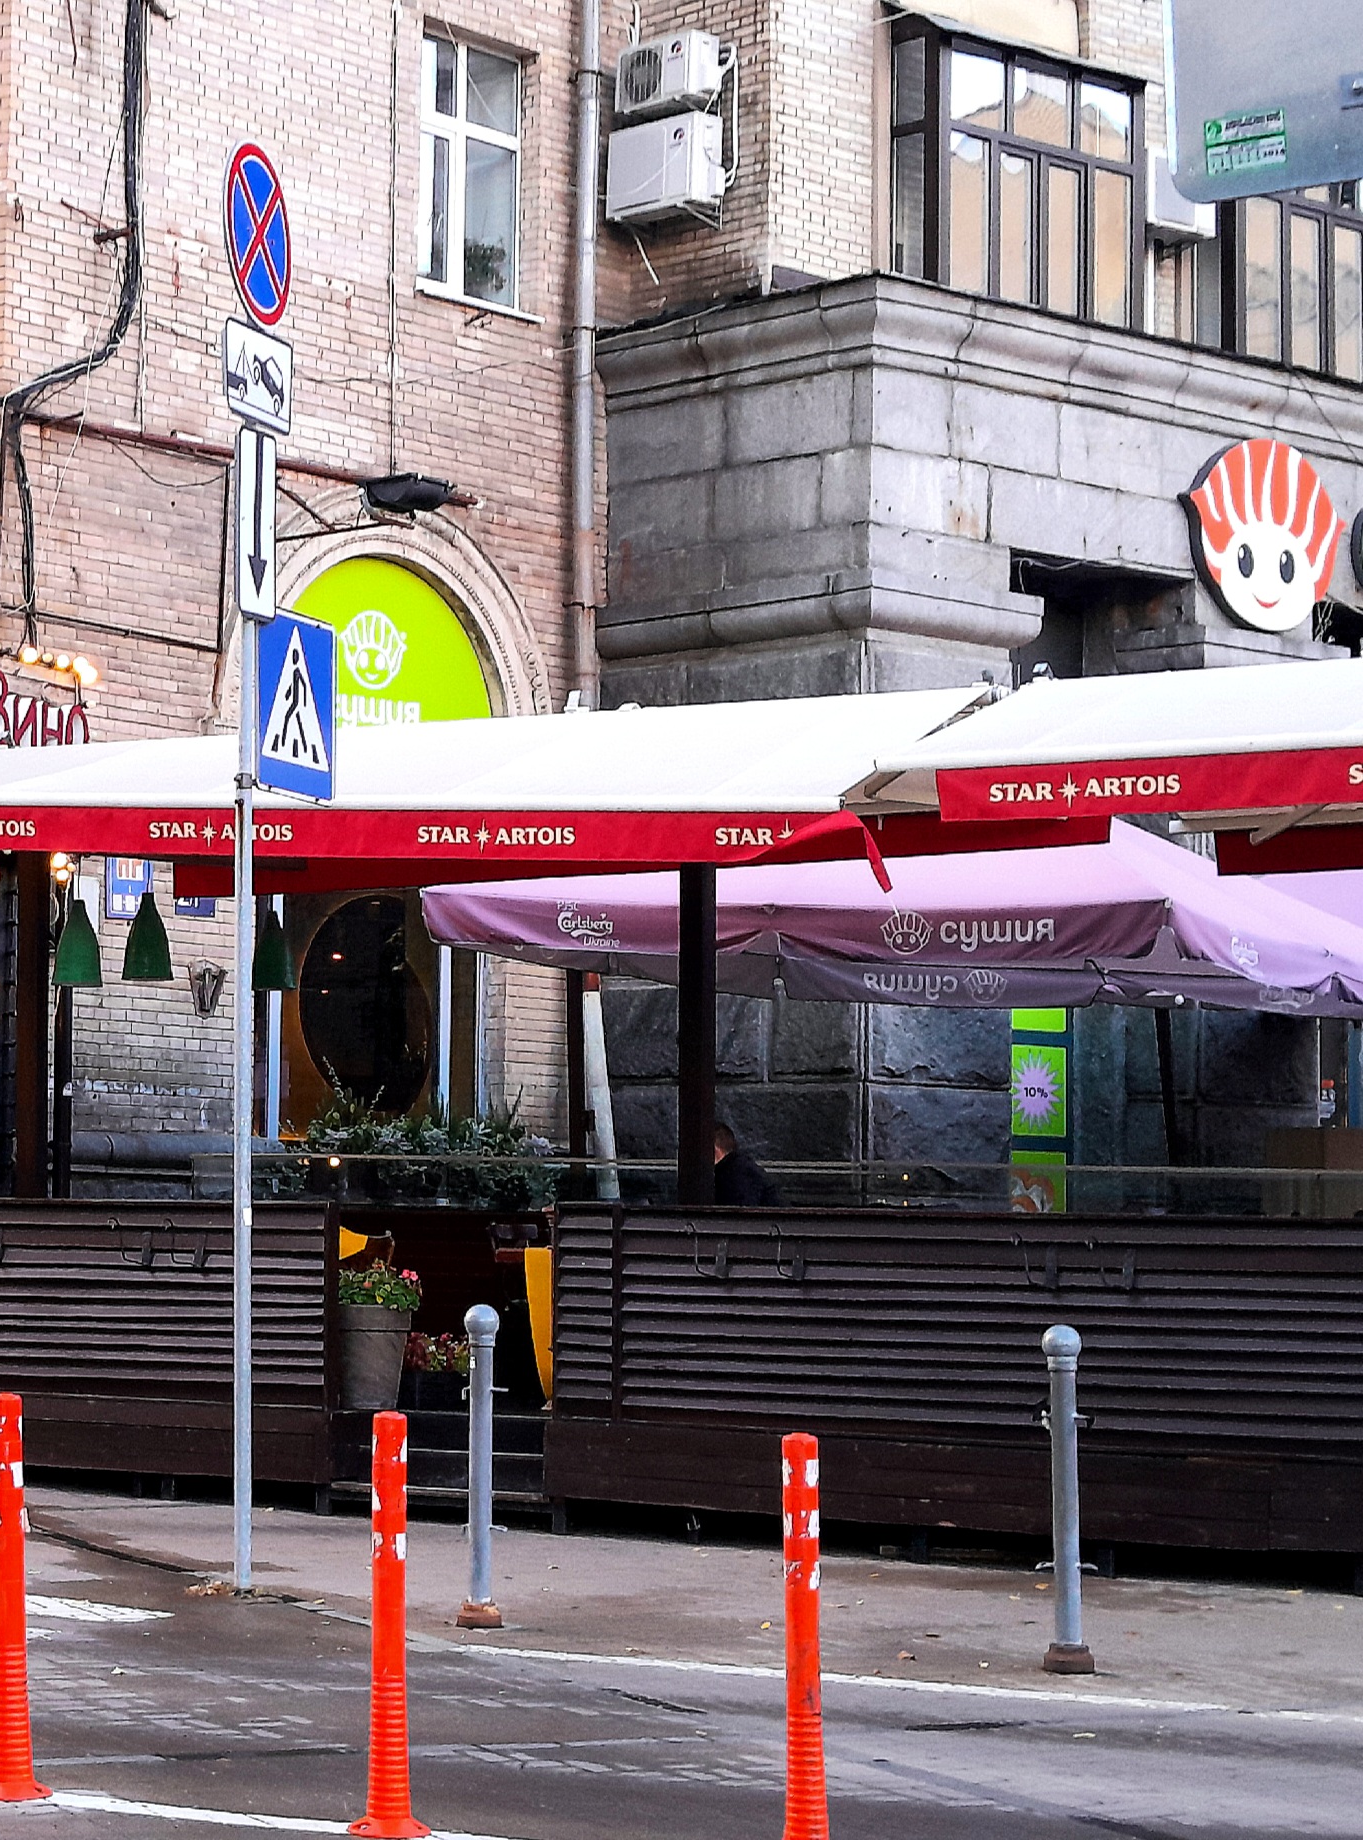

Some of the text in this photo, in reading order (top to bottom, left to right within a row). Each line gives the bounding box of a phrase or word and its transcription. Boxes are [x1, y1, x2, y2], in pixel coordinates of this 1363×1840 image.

[335, 693, 421, 723] ушия
[989, 774, 1181, 802] STAR ARTOIS
[148, 822, 294, 842] STAR ATOIS
[417, 826, 576, 846] STAR ARTOIS
[715, 827, 774, 846] STAR
[558, 911, 614, 936] Carlsberg
[583, 936, 621, 948] Ukraine
[939, 918, 1055, 952] сушия
[1023, 1086, 1049, 1098] 10%
